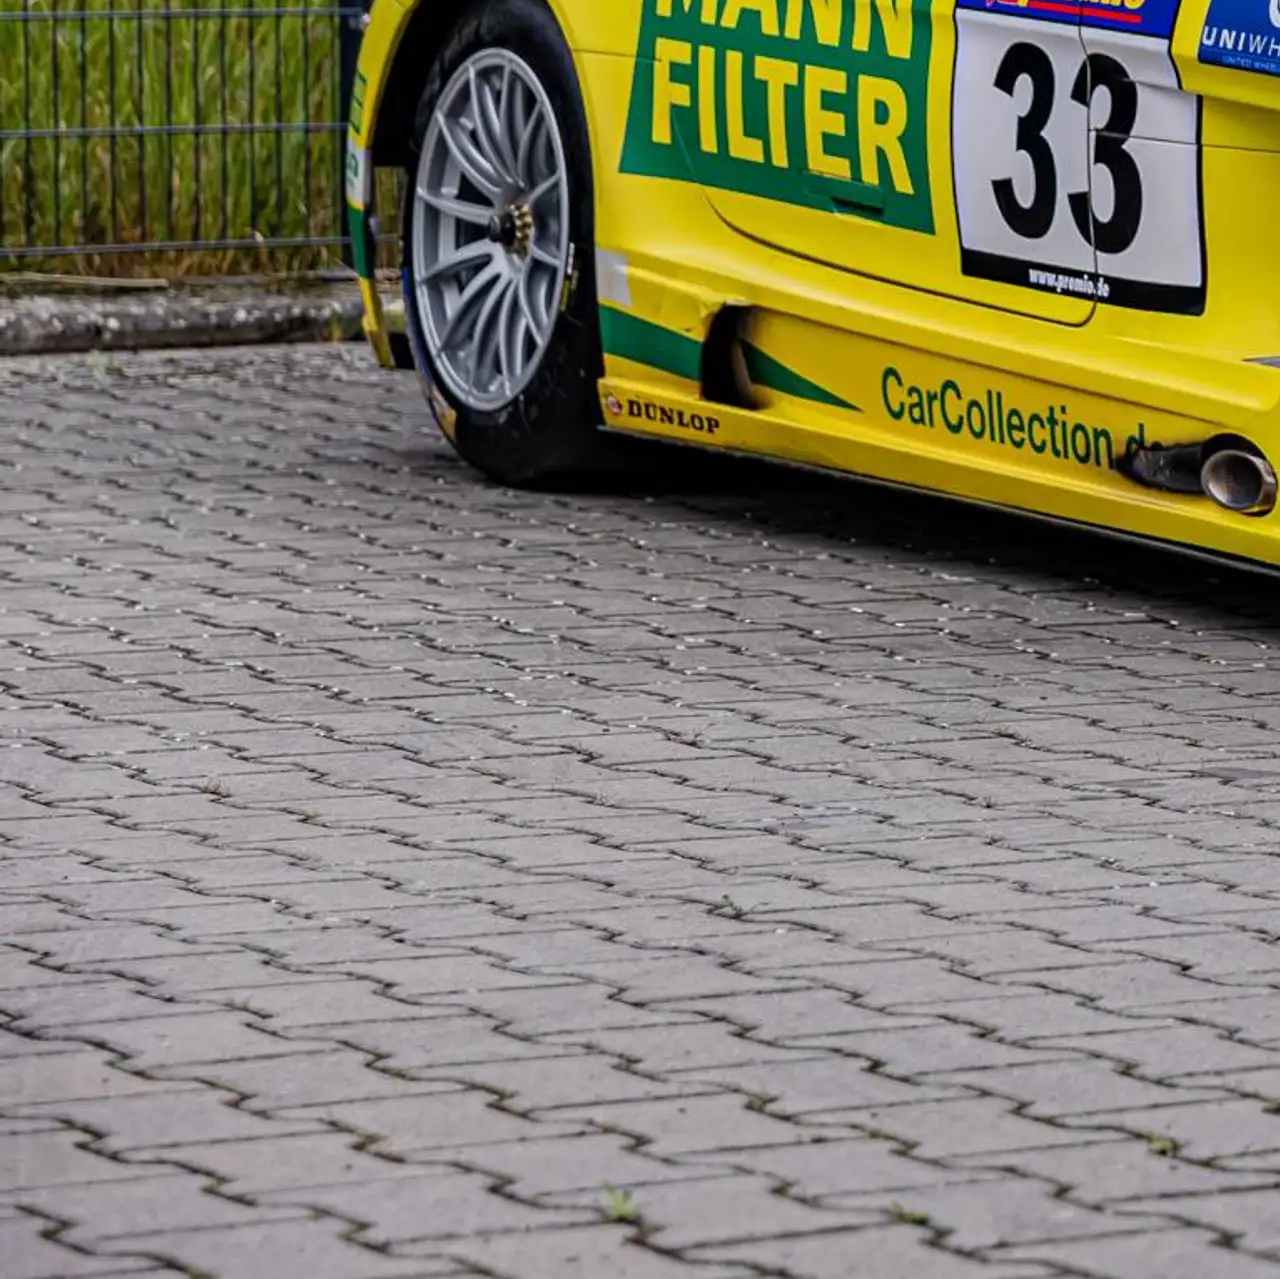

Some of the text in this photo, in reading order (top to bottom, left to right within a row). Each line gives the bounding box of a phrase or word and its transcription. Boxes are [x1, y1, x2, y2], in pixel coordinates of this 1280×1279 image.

[651, 37, 915, 195] FILTER
[991, 42, 1143, 255] 33
[1029, 268, 1110, 298] www.premio.de
[627, 399, 720, 434] DUNLOP
